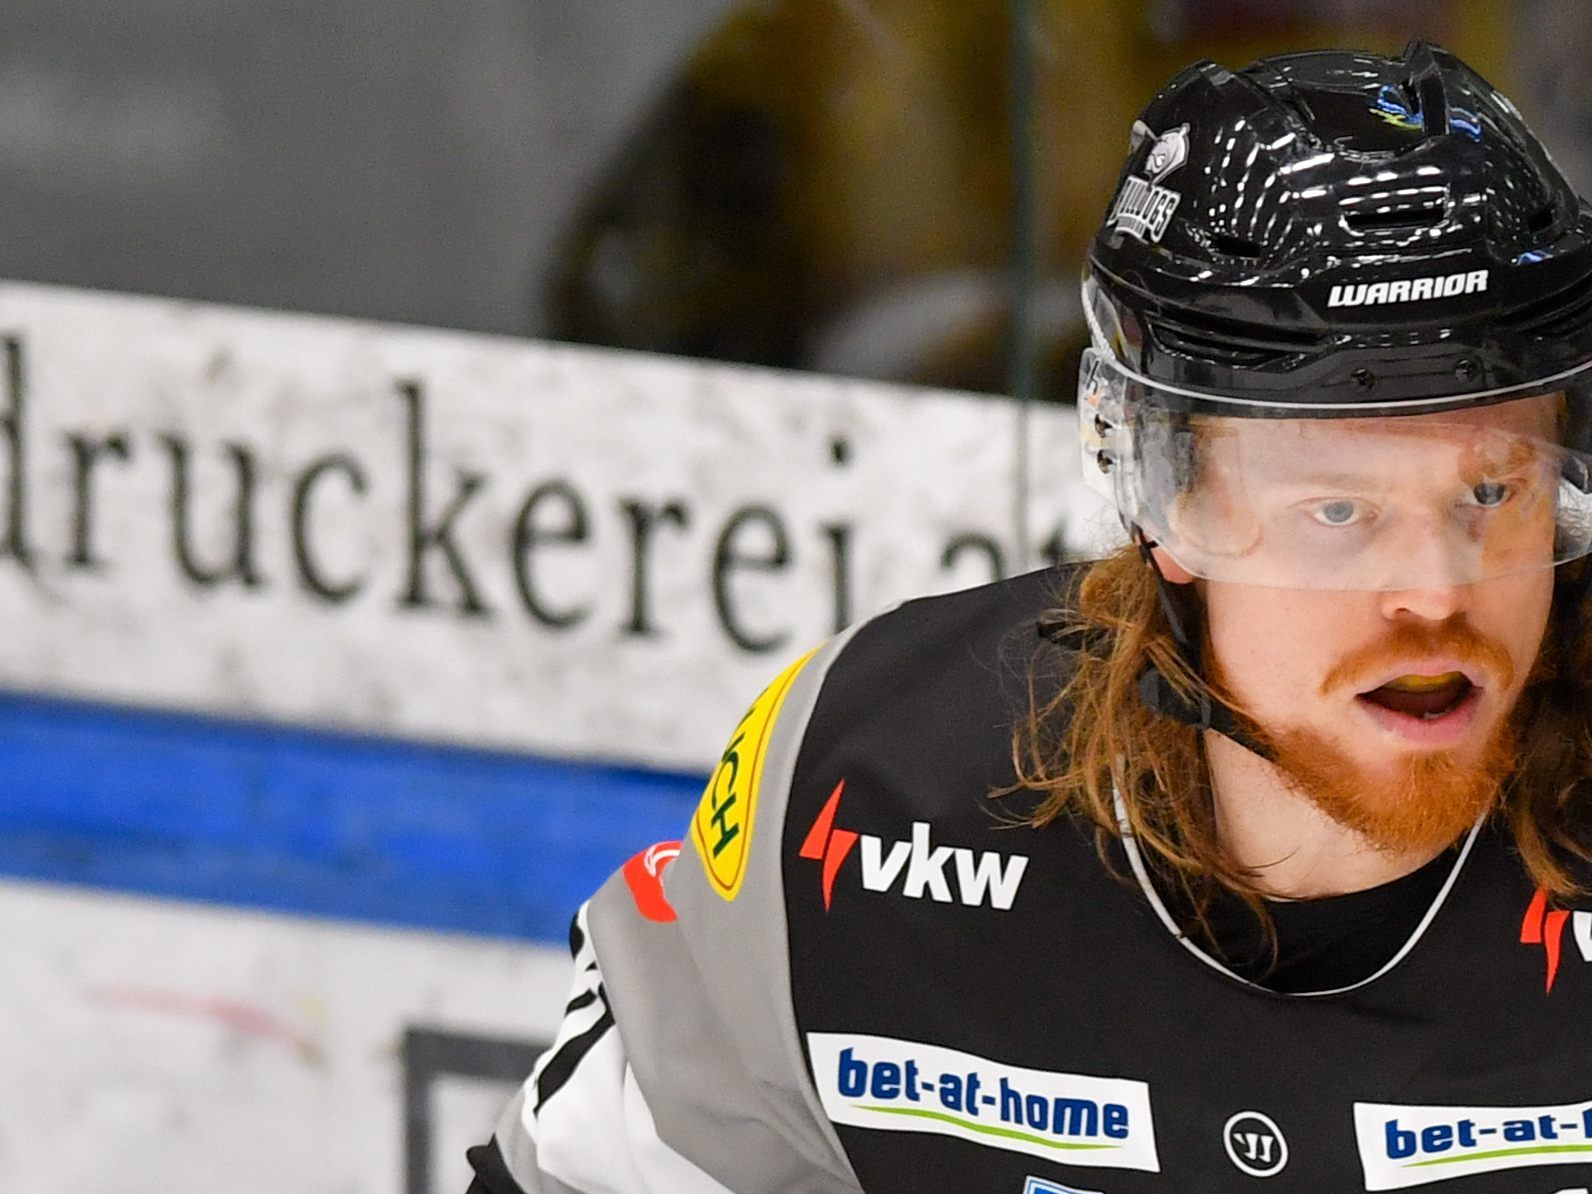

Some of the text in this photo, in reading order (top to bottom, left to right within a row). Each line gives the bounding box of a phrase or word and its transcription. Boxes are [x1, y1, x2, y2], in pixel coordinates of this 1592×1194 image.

[1327, 269, 1490, 309] WARRIOR
[859, 821, 1029, 911] vkw
[837, 1047, 1130, 1140] bet-at-home
